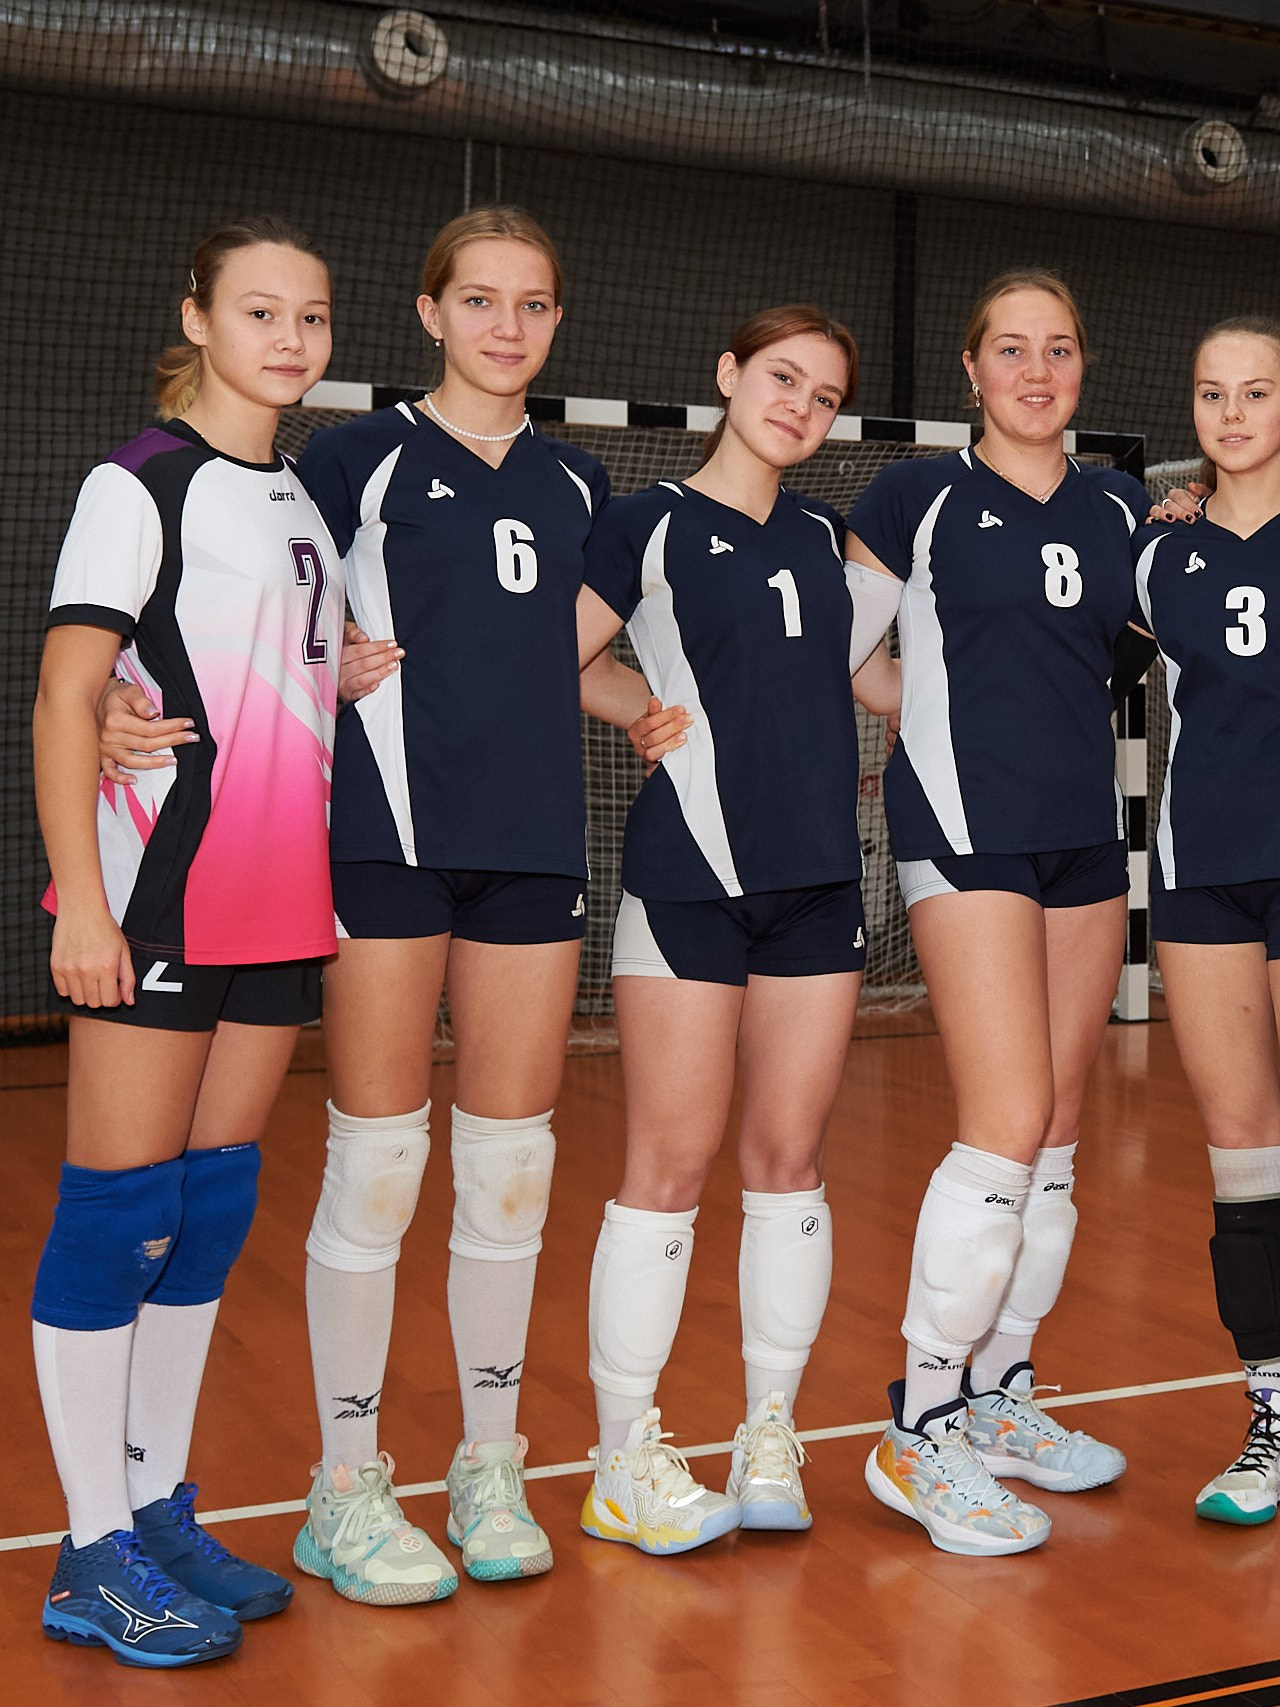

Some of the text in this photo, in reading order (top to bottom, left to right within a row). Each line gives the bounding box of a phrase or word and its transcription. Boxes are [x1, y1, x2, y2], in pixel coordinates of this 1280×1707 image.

[493, 519, 538, 593] 6
[1041, 543, 1082, 607] 8
[288, 538, 328, 665] 2
[768, 570, 802, 637] 1
[1225, 586, 1266, 656] 3
